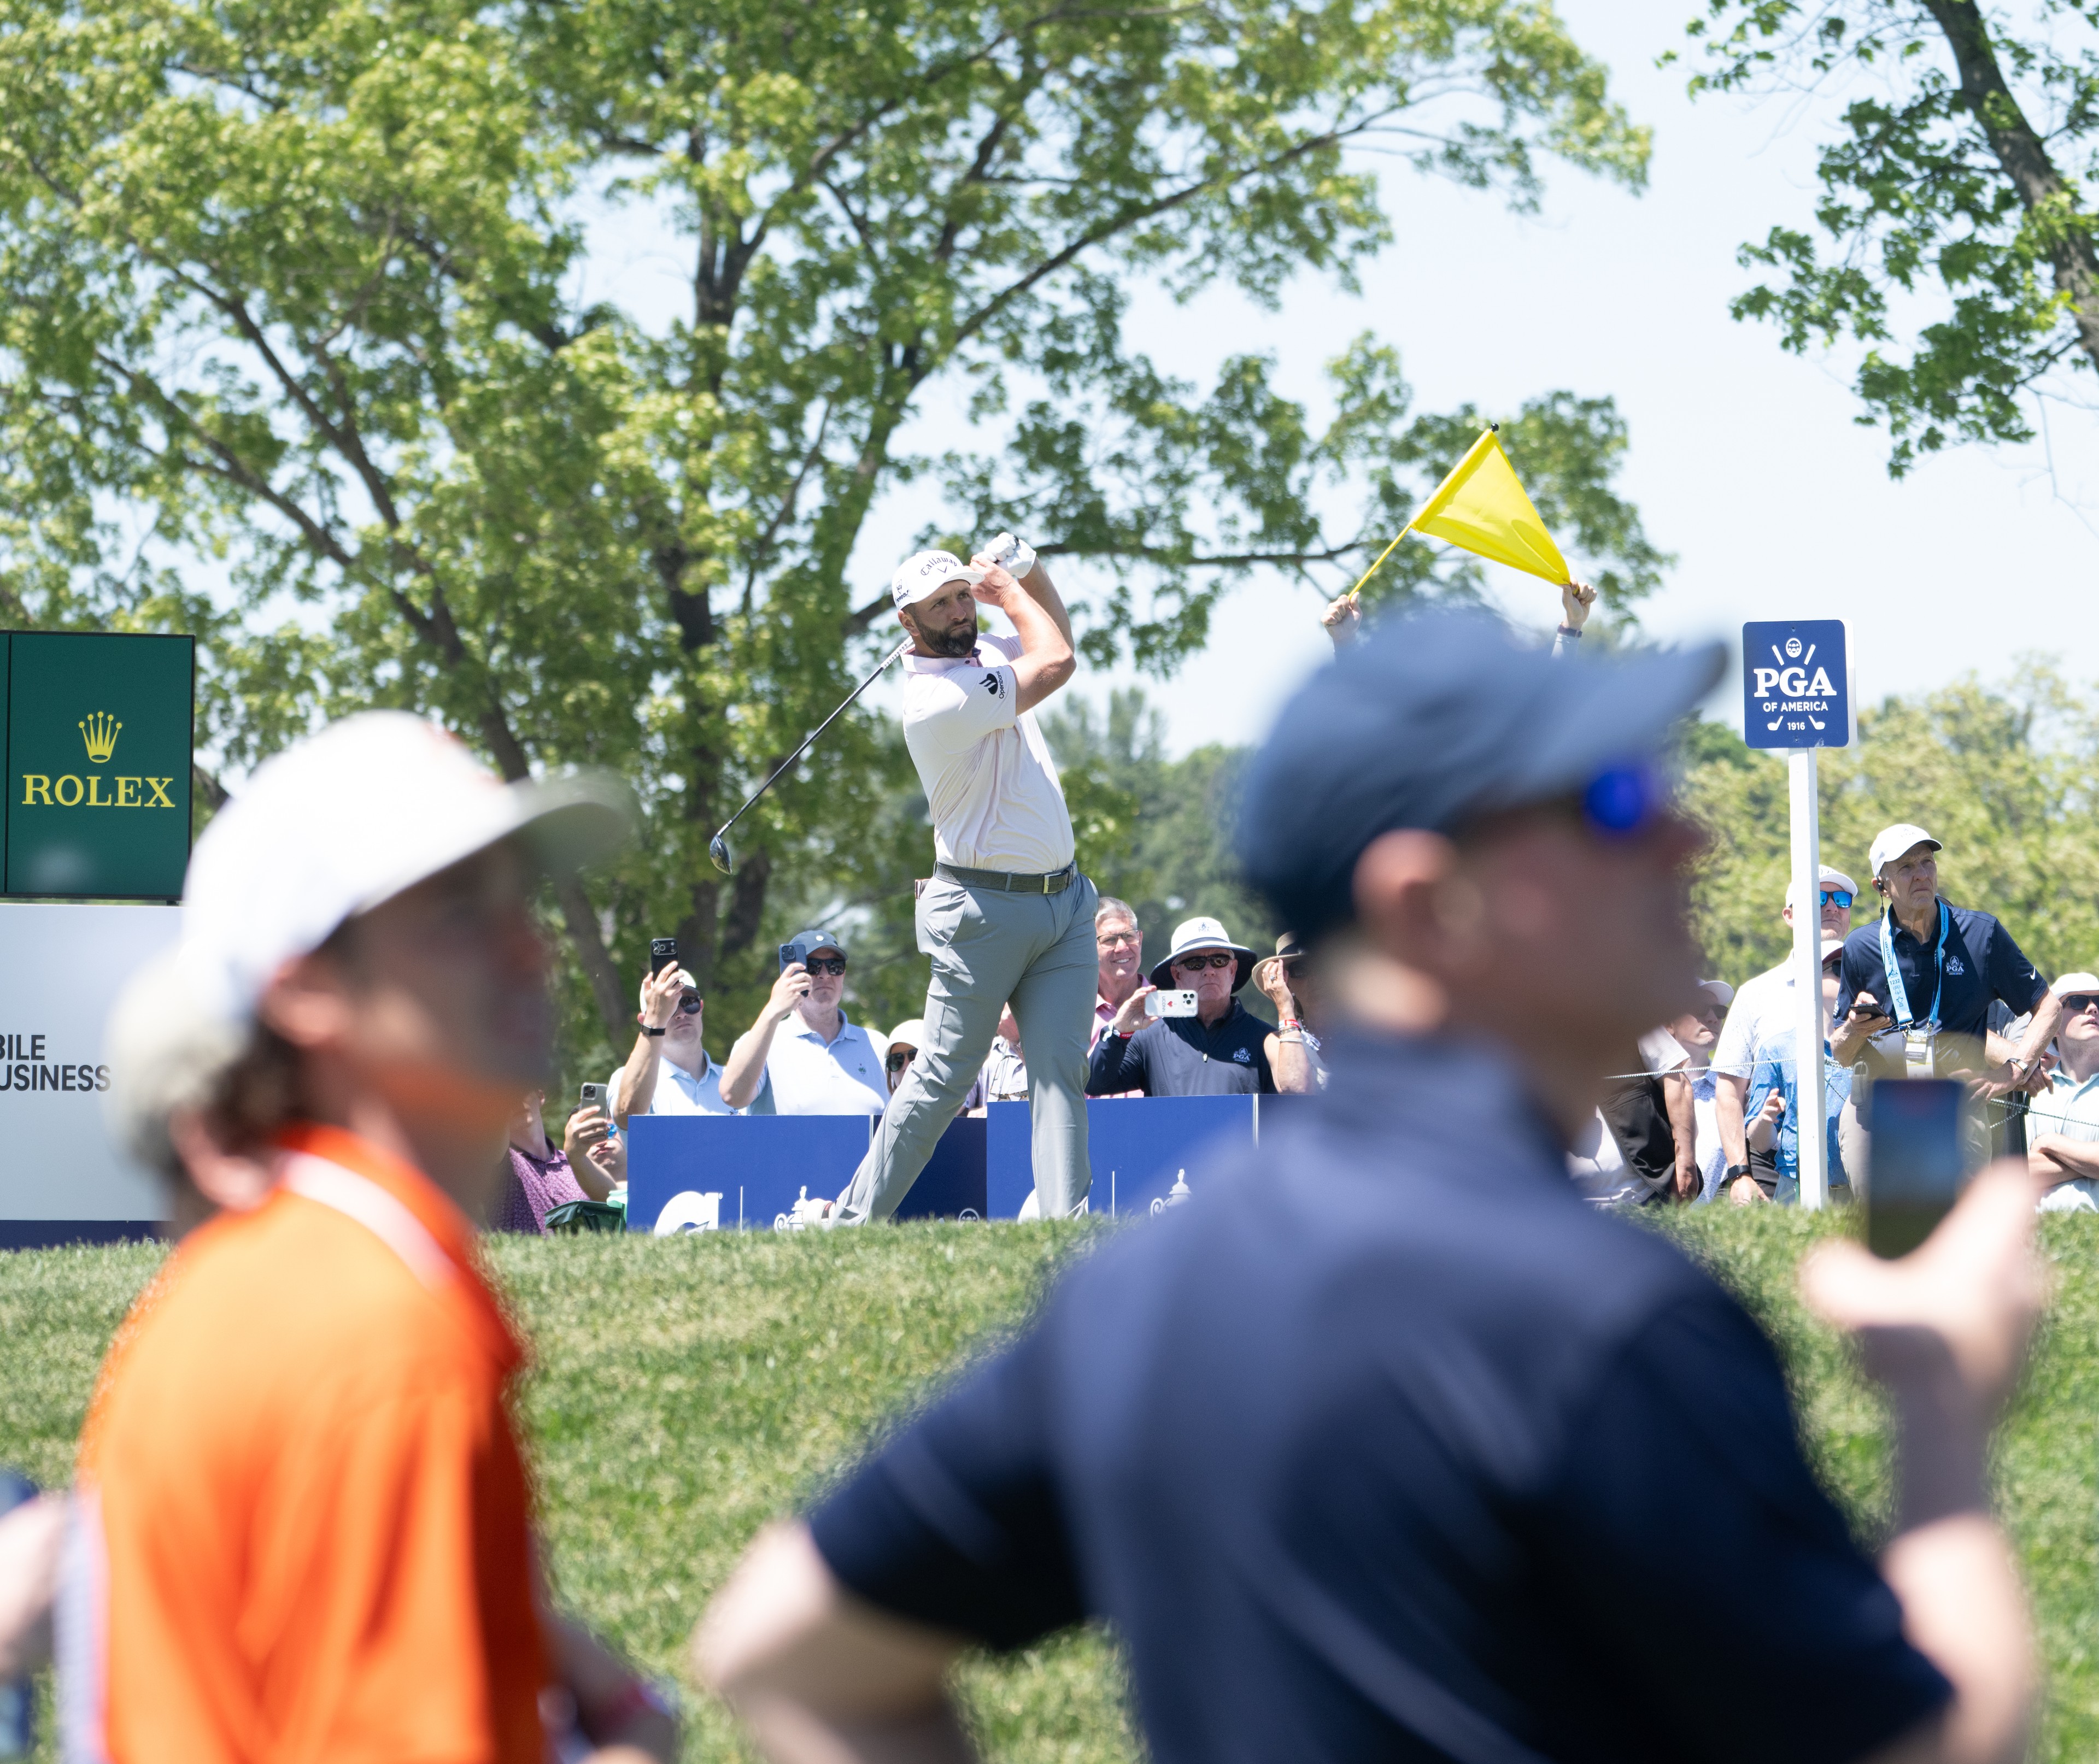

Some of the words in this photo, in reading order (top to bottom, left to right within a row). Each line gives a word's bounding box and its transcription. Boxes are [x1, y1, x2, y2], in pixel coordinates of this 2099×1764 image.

[920, 557, 957, 575] Callaway
[1754, 667, 1837, 698] PGA
[1763, 702, 1778, 712] OF
[1780, 701, 1828, 712] AMERICA
[1787, 722, 1805, 731] 1916
[22, 775, 175, 807] ROLEX
[0, 1064, 111, 1092] USINESS
